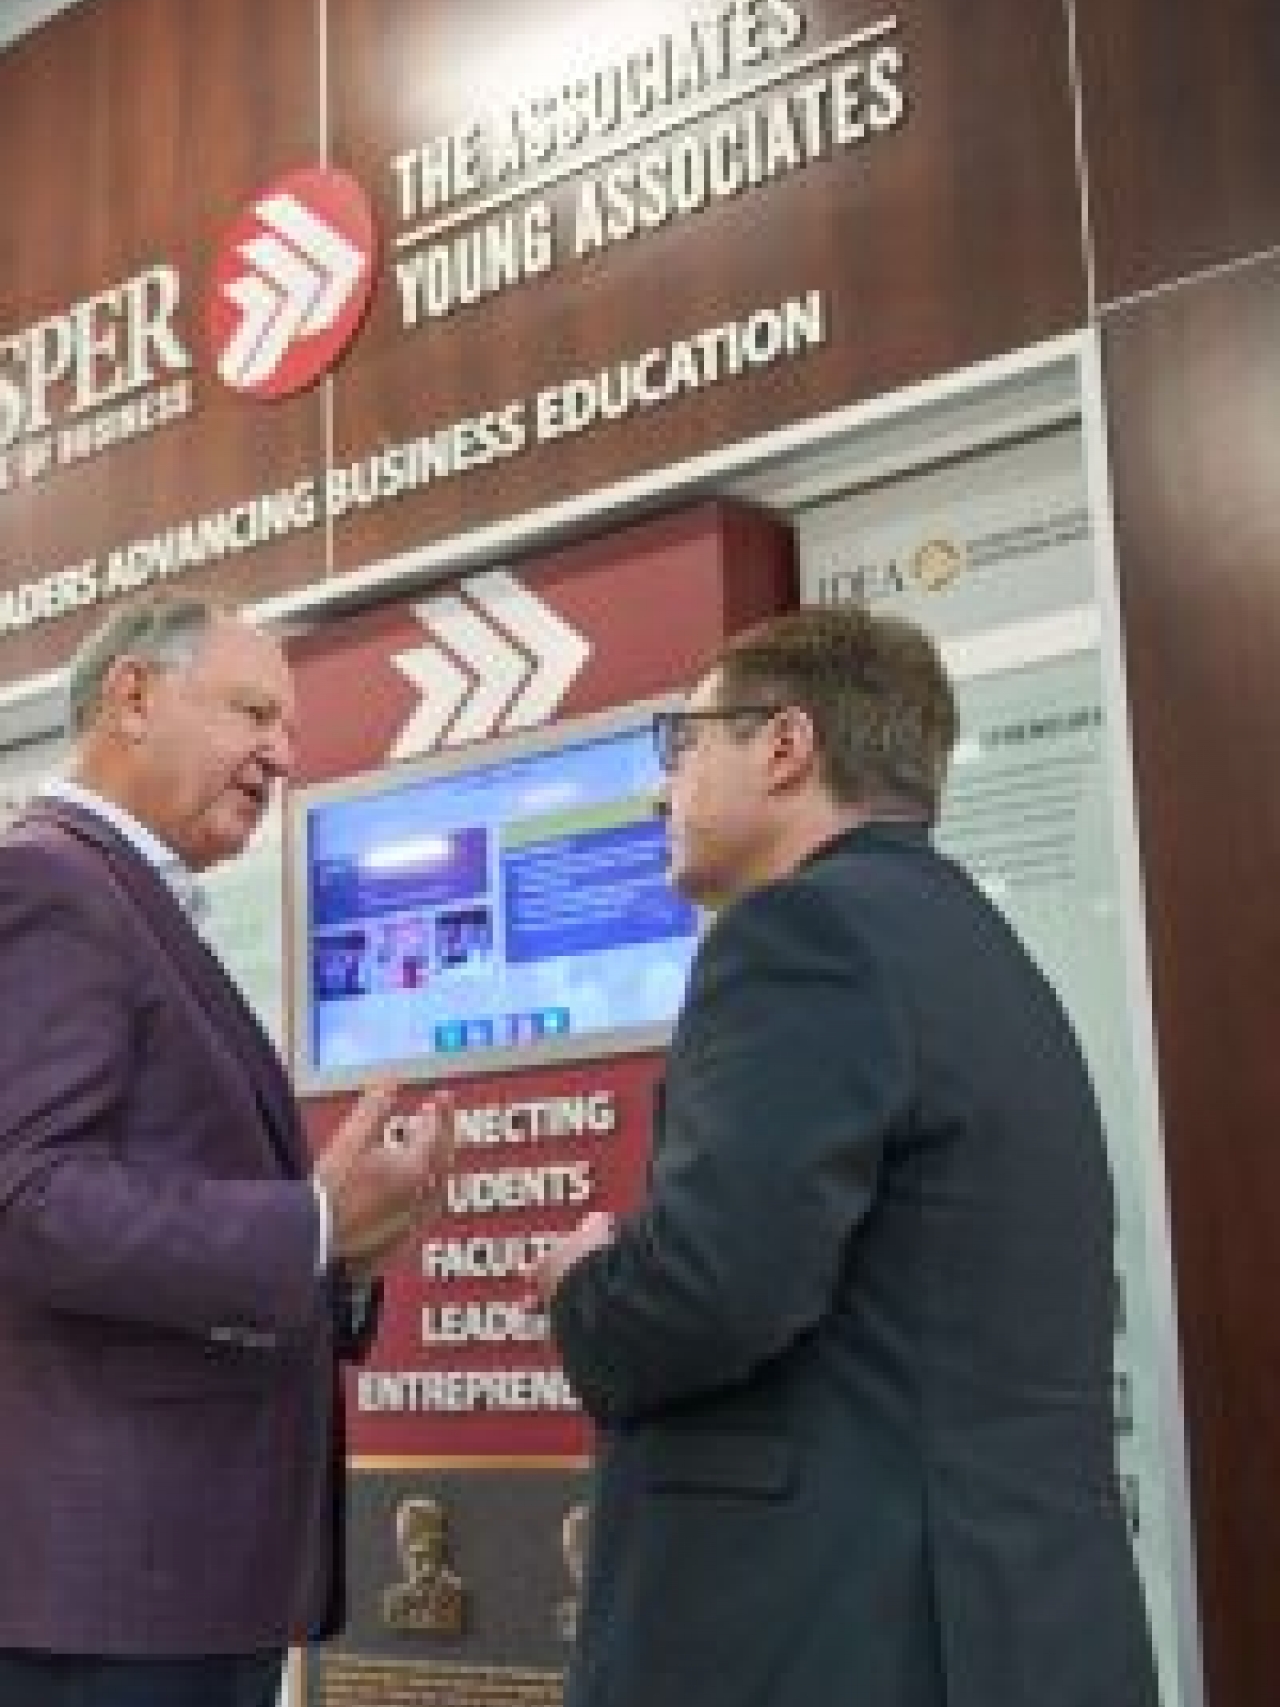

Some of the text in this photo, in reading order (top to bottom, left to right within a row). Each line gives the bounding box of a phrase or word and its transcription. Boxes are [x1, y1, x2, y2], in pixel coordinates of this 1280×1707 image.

[392, 124, 482, 222] THE
[395, 46, 906, 329] YOUNG ASSOCIATES
[104, 477, 317, 596] ADVANCING
[325, 401, 526, 516] BUSINESS
[535, 290, 825, 442] EDUCATION
[446, 1160, 592, 1216] UDENTS
[421, 1231, 560, 1283] FACULT
